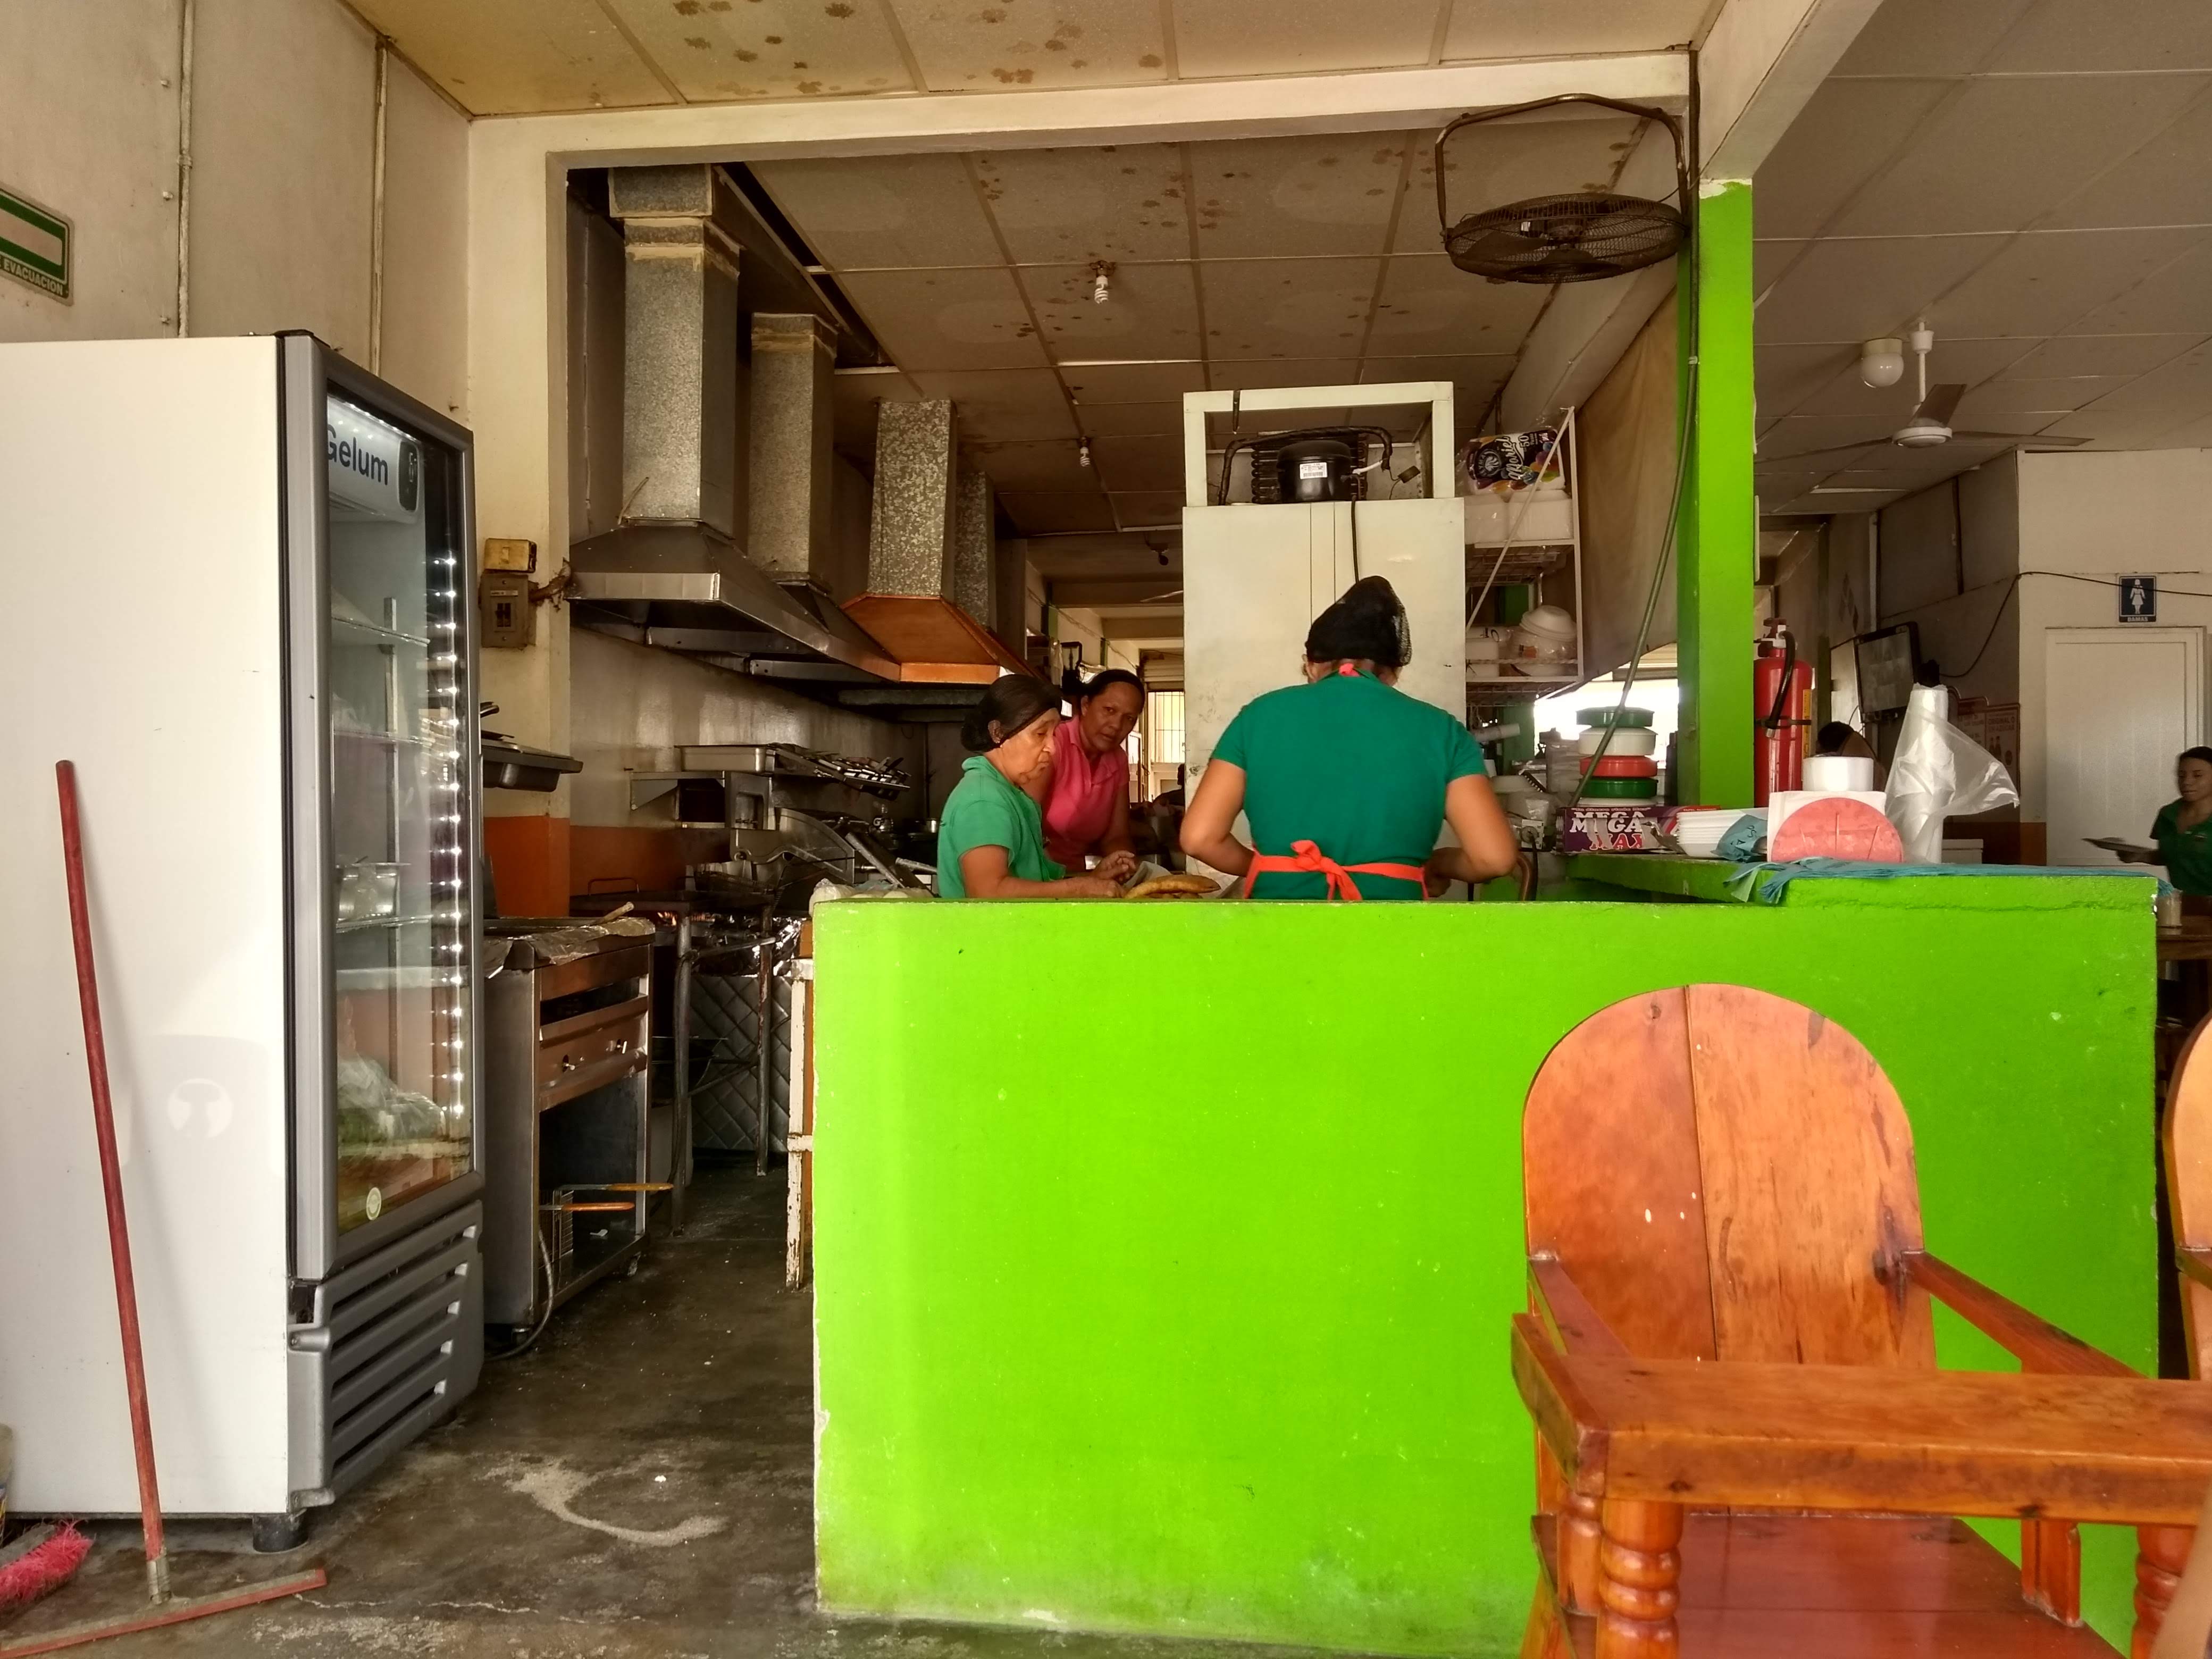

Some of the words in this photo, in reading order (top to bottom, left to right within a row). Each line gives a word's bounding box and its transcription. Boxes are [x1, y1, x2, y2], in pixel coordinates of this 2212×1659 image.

[328, 424, 388, 485] Gelum
[1495, 435, 1523, 480] Mariel
[1518, 435, 1530, 448] 50
